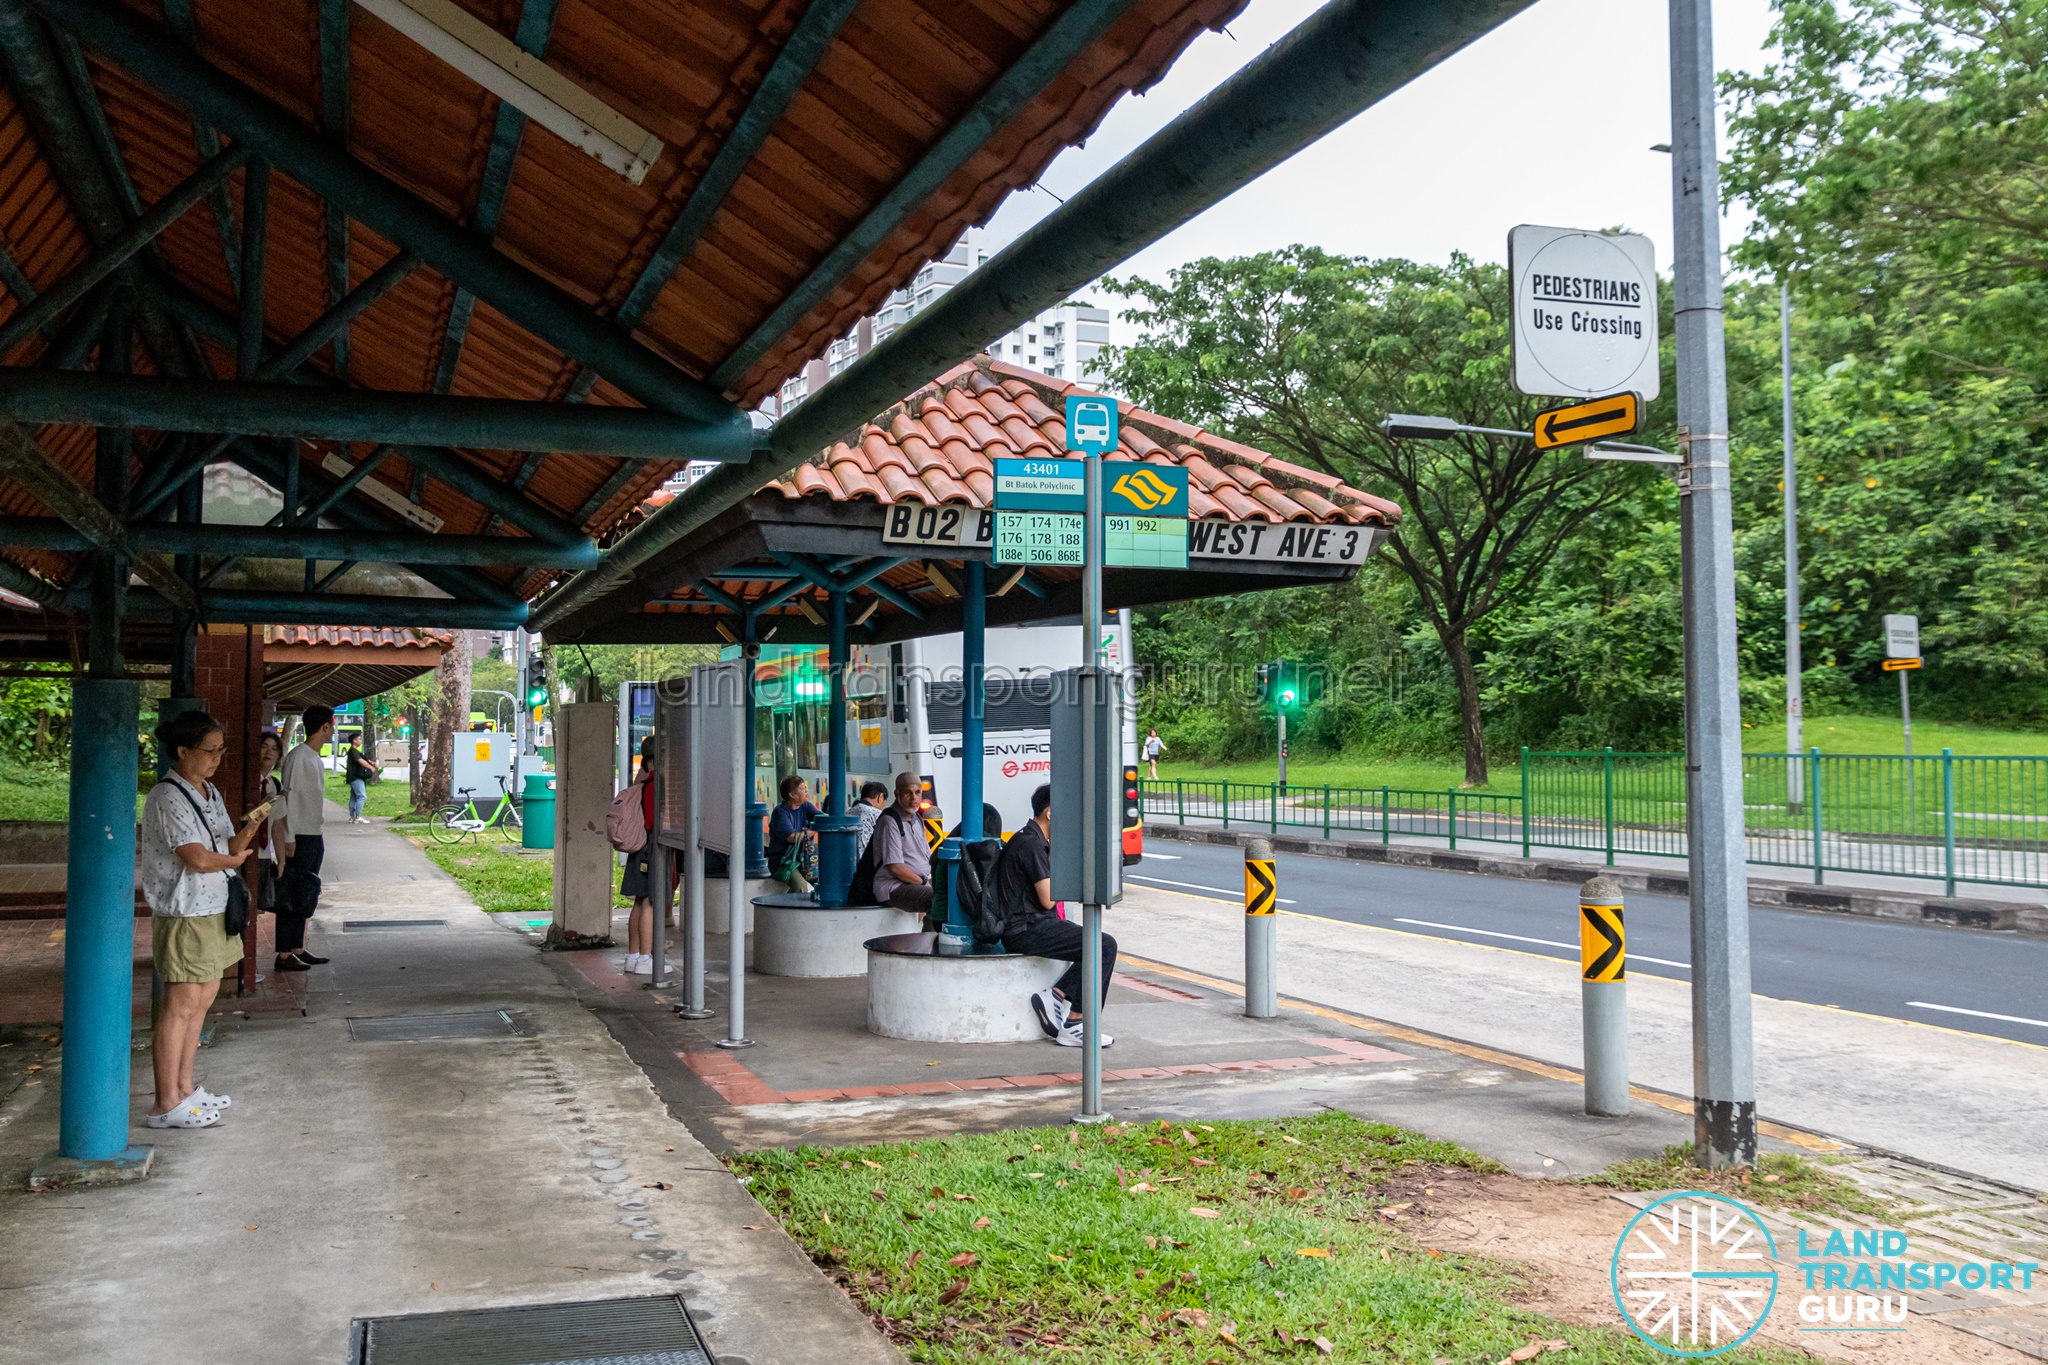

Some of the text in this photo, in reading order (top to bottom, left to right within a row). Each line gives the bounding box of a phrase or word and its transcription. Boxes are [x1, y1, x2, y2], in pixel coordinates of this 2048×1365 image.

[1533, 274, 1640, 303] PEDESTRIANS
[1533, 308, 1641, 340] Use Crossing
[1023, 463, 1060, 475] 43401
[1005, 480, 1076, 491] Bt Batok Polyclinic
[1000, 516, 1081, 529] 157 174 174e
[1109, 519, 1157, 532] 991 992
[889, 506, 960, 541] B02
[1189, 521, 1267, 555] WEST
[1339, 530, 1359, 560] 3
[1000, 532, 1080, 545] 176 178 188
[999, 549, 1081, 562] 188e 506 868E
[1021, 761, 1051, 772] SMR
